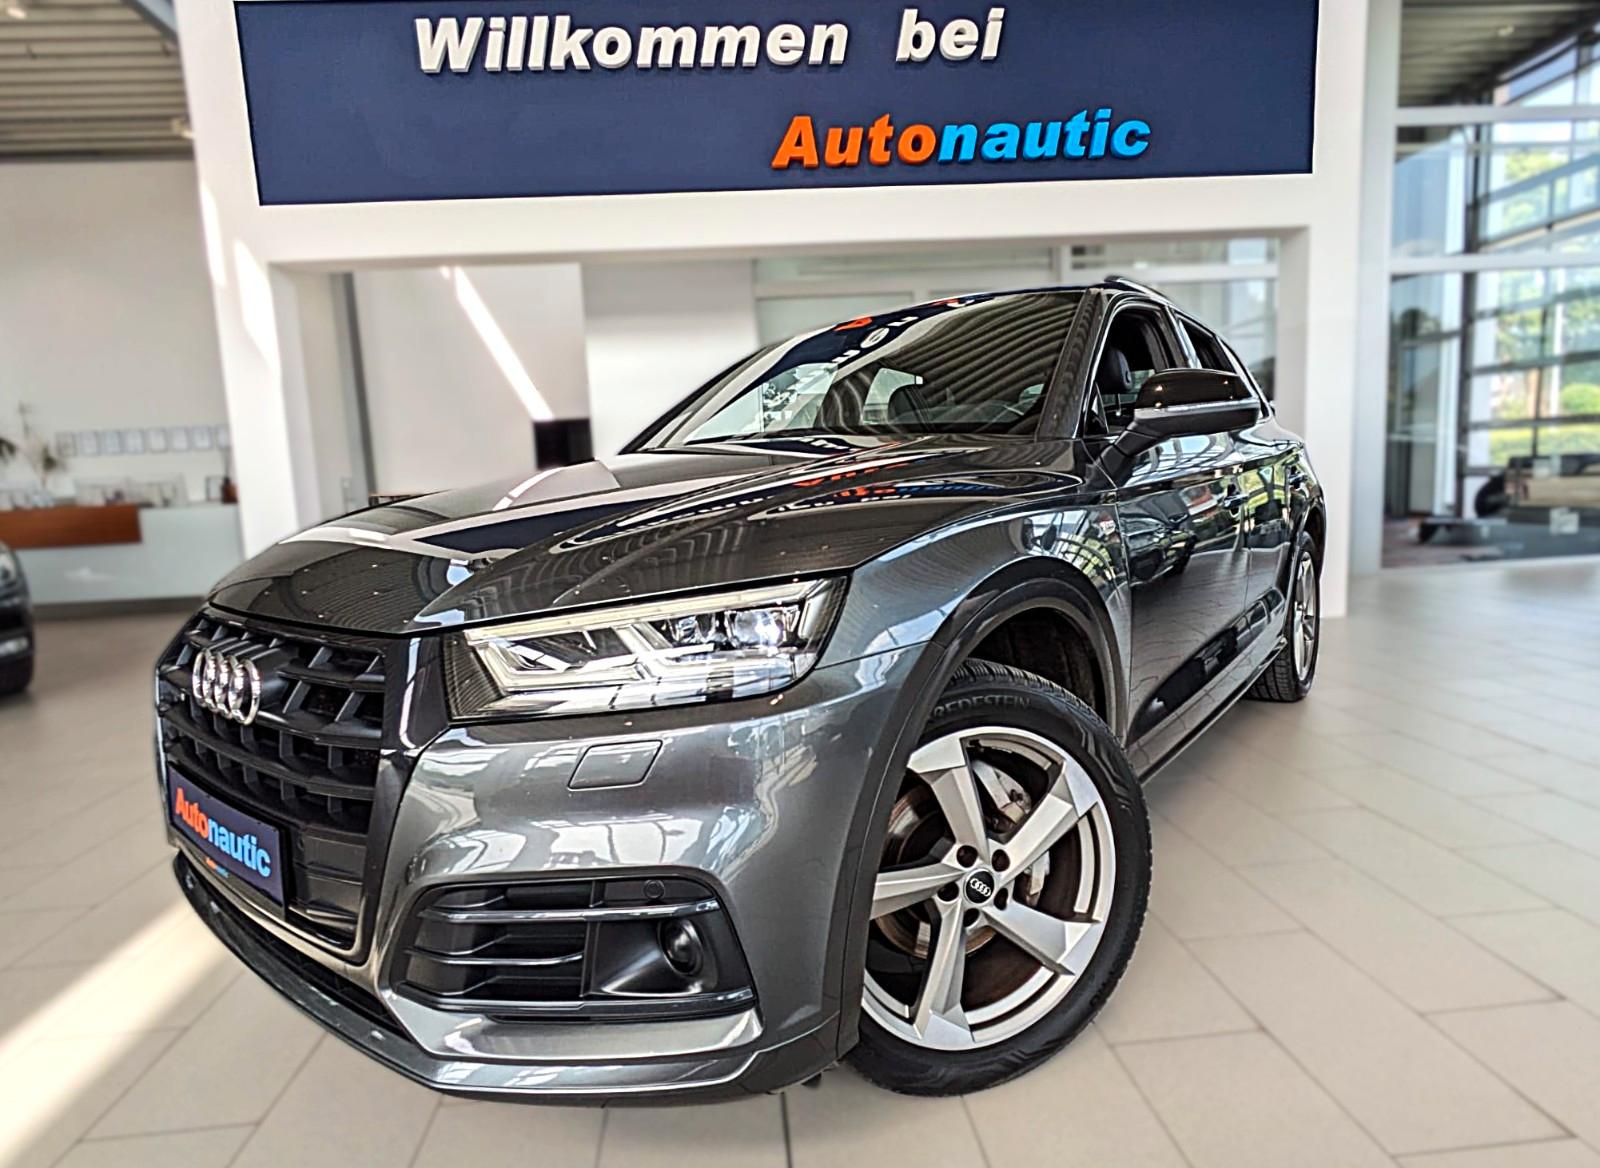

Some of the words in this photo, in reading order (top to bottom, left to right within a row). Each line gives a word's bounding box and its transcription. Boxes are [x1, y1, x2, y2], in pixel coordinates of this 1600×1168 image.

[414, 15, 849, 74] Willkommen
[895, 7, 1006, 63] bei
[771, 108, 1152, 169] Autonautic
[933, 694, 1031, 718] REDESTEIN
[175, 787, 272, 878] Autonautic
